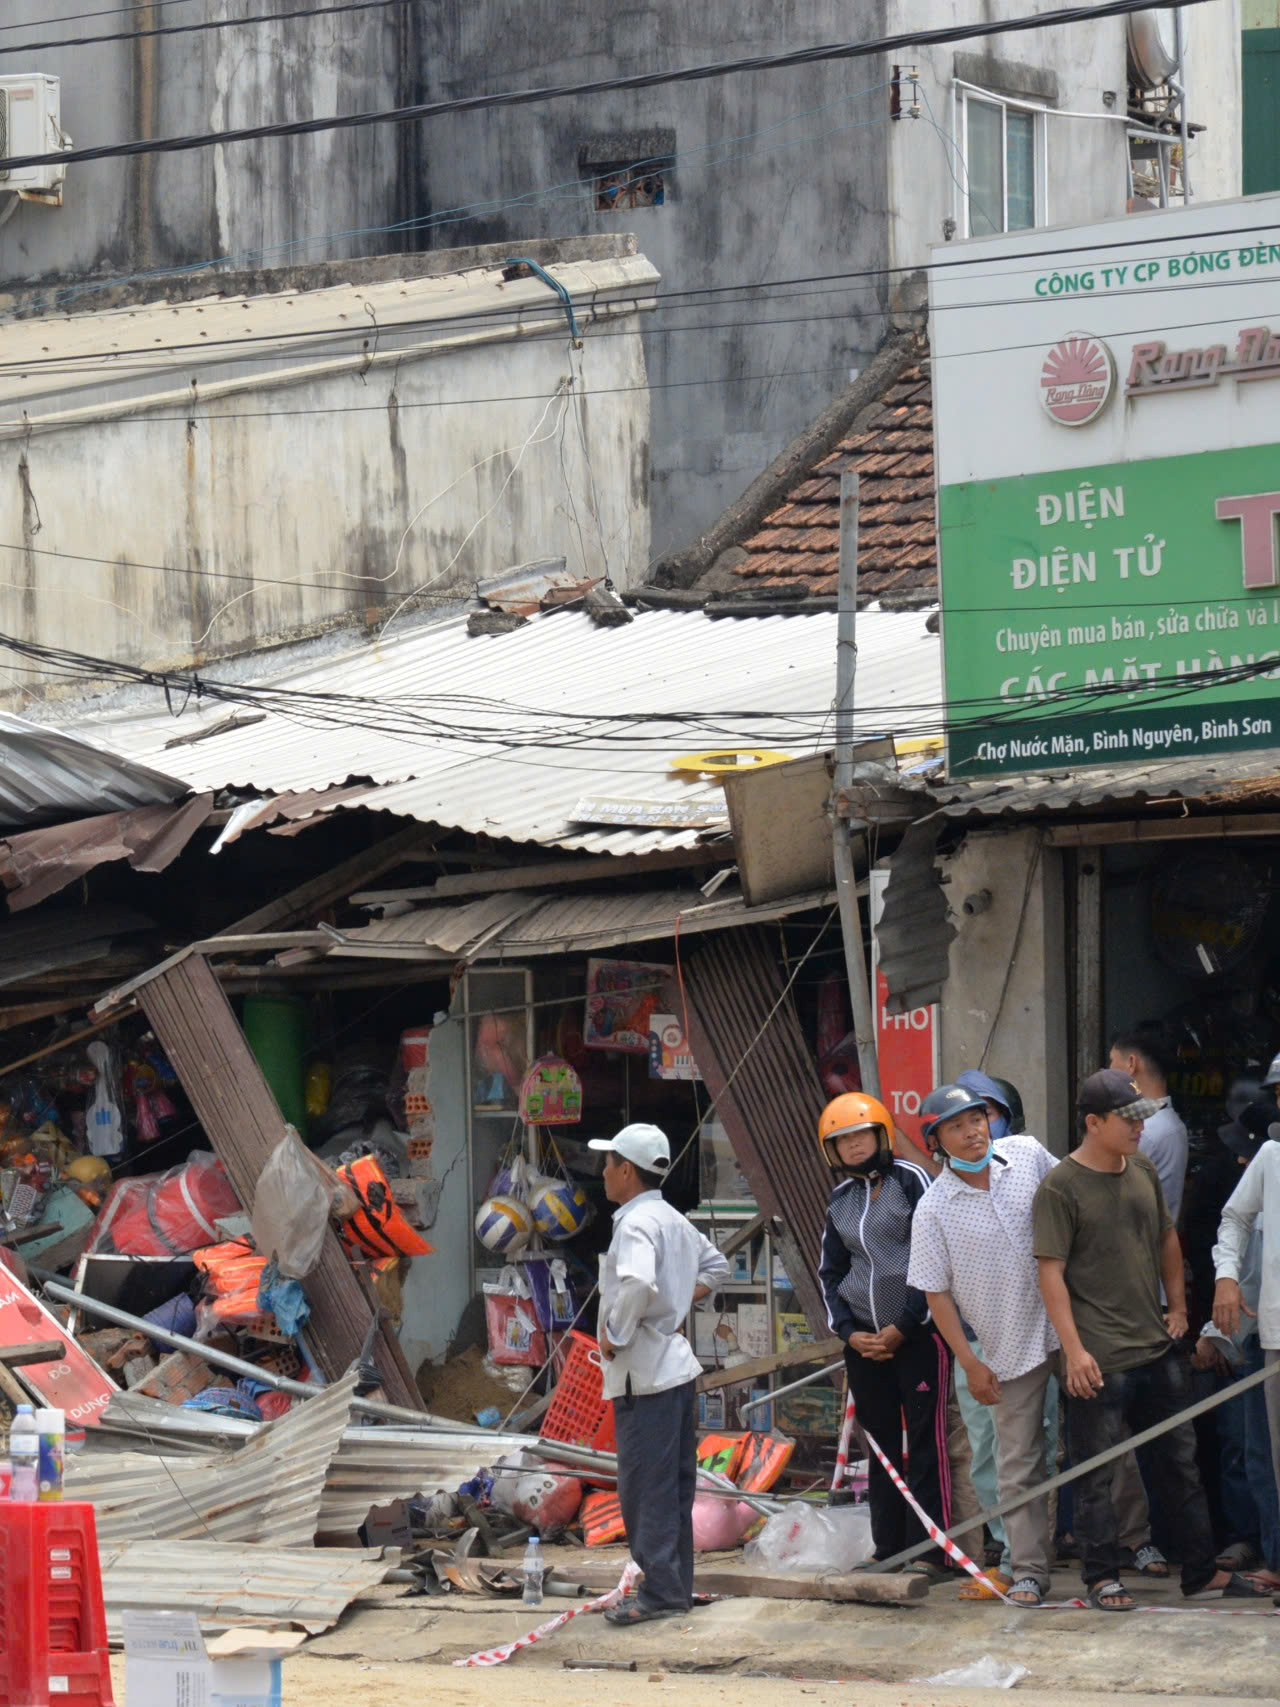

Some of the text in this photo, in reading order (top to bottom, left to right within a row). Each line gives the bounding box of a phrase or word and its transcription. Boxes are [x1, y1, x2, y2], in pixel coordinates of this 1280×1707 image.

[1035, 272, 1094, 296] CÔNG
[1101, 266, 1128, 288] TY
[1134, 262, 1159, 282] CP
[1168, 251, 1230, 277] BÓNG
[1036, 481, 1125, 529] ĐIỆN
[1010, 534, 1166, 593] ĐIỆN TỬ
[1216, 492, 1280, 589] T
[996, 624, 1061, 655] Chuyên
[1067, 624, 1106, 645] mua
[1157, 608, 1189, 635] sửa
[1195, 606, 1239, 631] chữa
[1246, 600, 1268, 626] và
[1000, 665, 1067, 705] CÁC
[977, 742, 1007, 763] Chợ
[1010, 735, 1048, 758] Nước
[1093, 729, 1129, 750] Bình
[1202, 718, 1238, 739] Bình
[1242, 717, 1272, 735] Sơn
